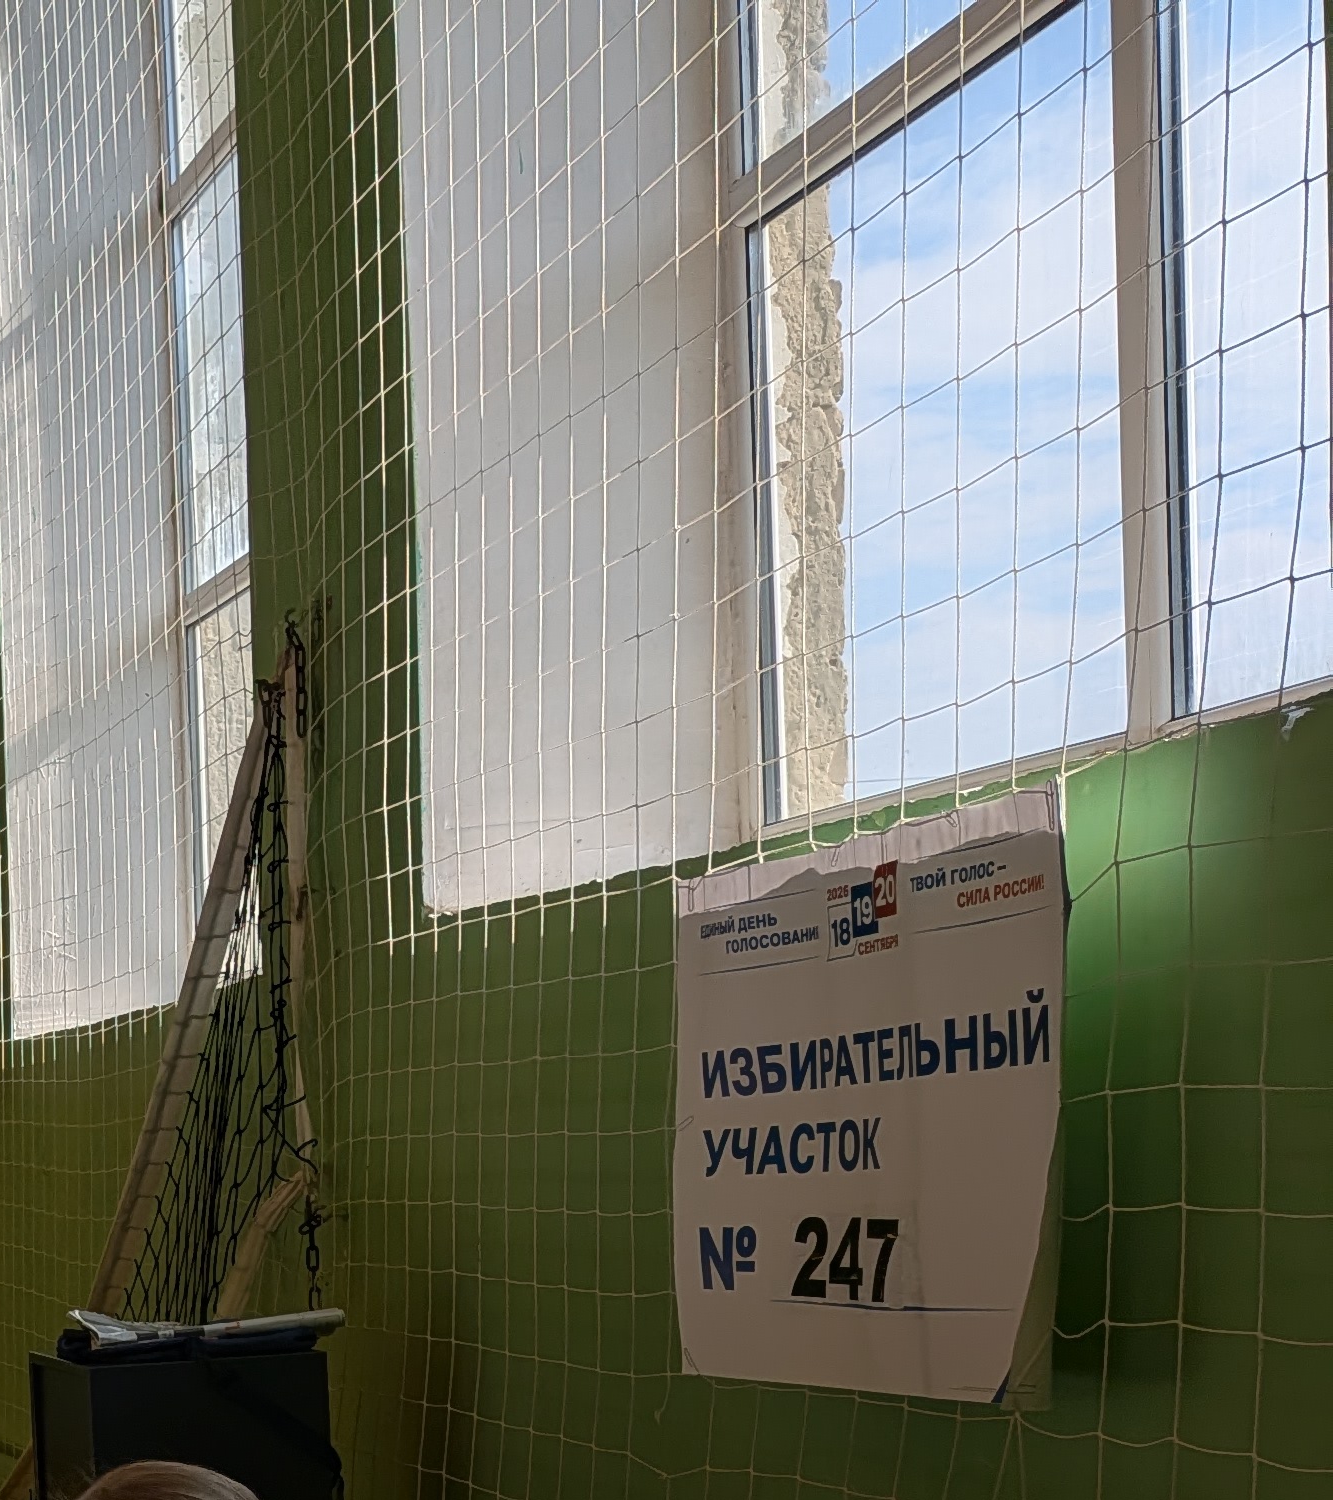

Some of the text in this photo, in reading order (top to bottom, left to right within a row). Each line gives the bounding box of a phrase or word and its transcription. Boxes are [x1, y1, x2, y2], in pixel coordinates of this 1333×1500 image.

[910, 867, 946, 892] ТВОЙ
[950, 861, 995, 885] ГОЛОС
[956, 873, 1045, 908] СИЛА РОССИИ!
[738, 912, 778, 934] ДЕНЬ
[831, 874, 895, 947] 18 19 20
[857, 933, 899, 955] СЕНТЯБРЯ
[702, 987, 1052, 1099] ИЗБИРАТЕЛЬНЫЙ
[703, 1117, 881, 1177] УЧАСТОК
[699, 1217, 899, 1303] № 247
